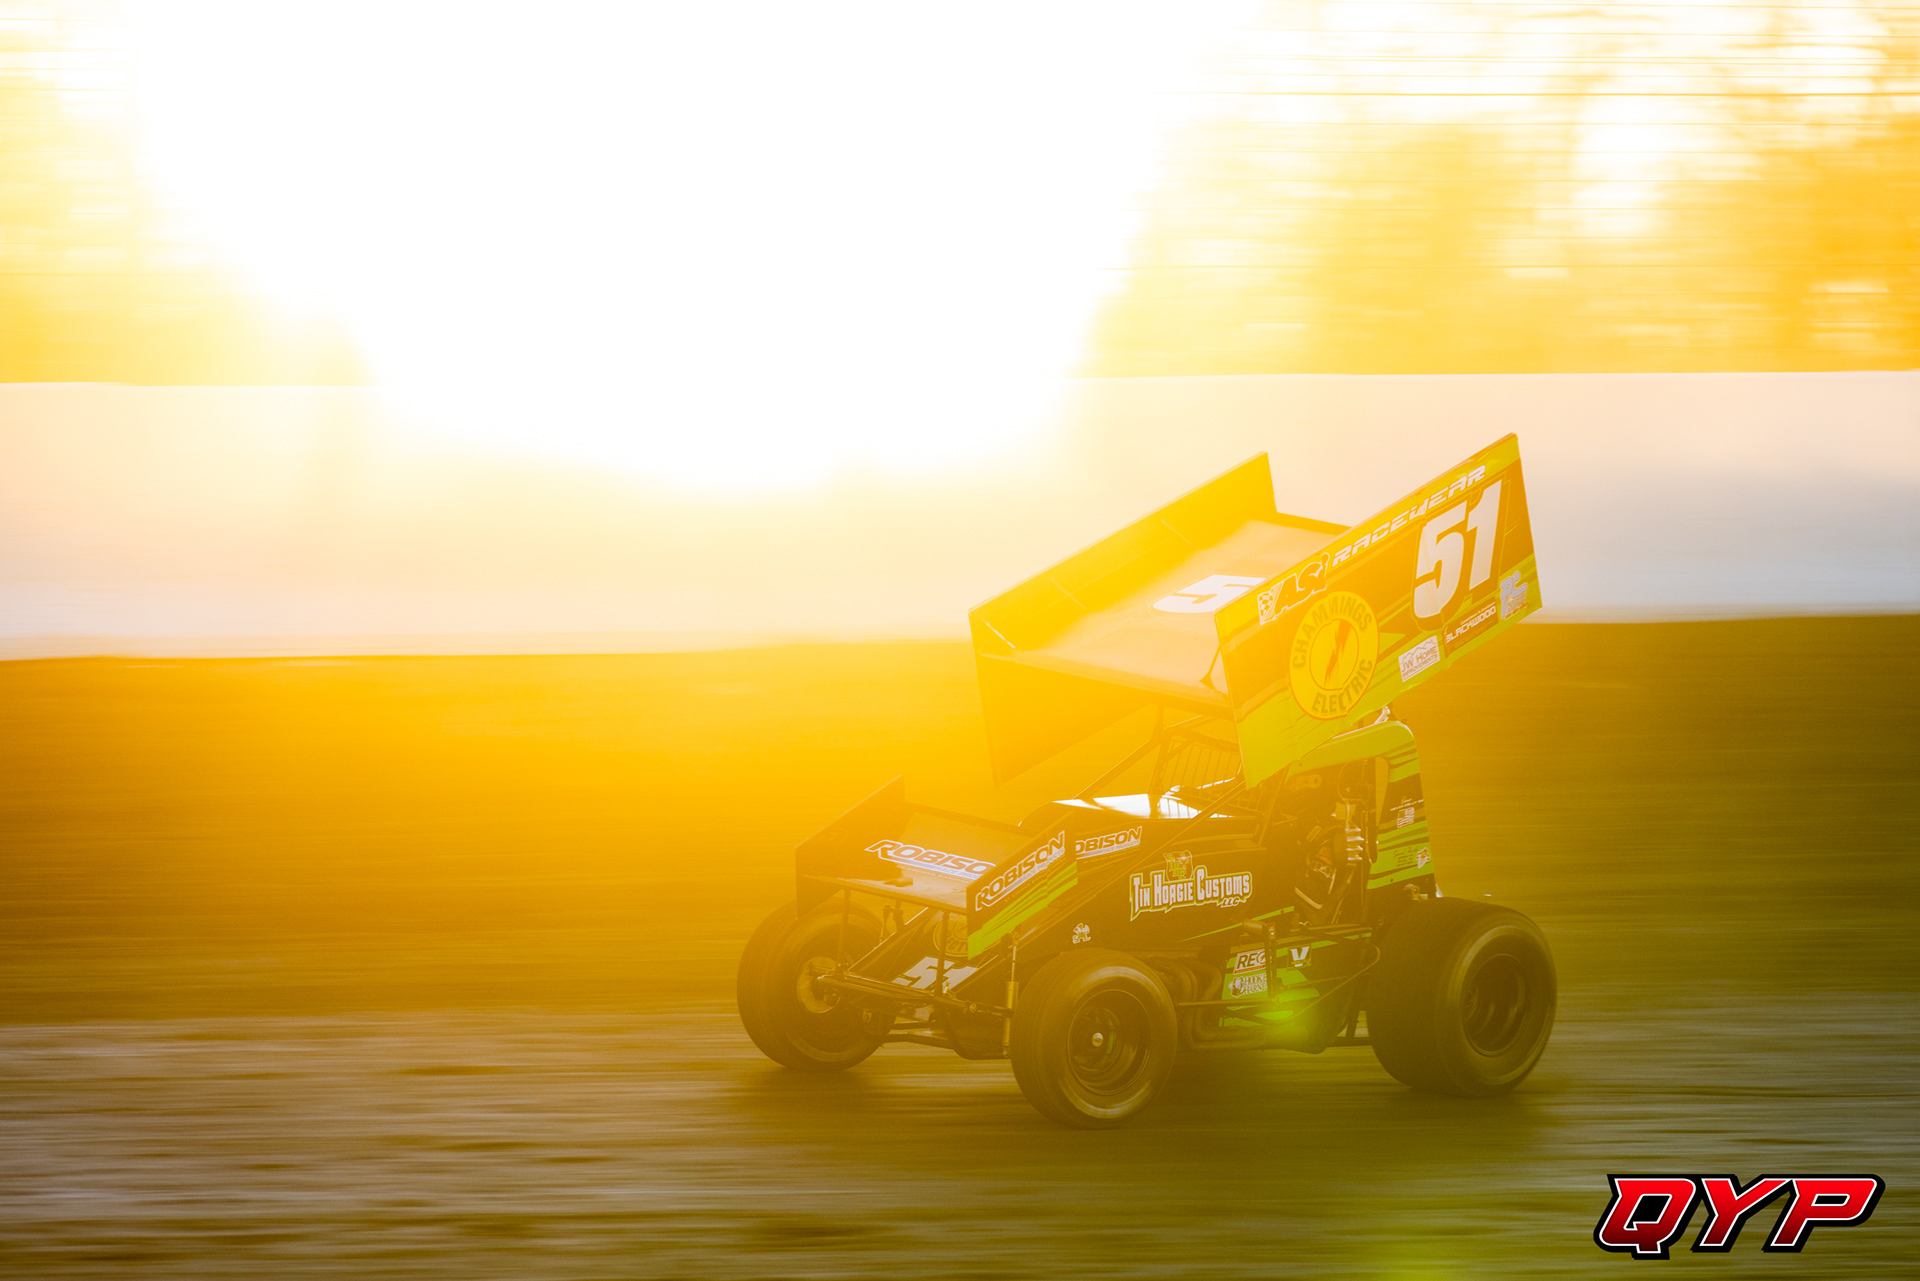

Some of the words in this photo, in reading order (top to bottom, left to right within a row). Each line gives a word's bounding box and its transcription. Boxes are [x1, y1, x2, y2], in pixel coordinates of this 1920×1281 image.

[1331, 464, 1487, 568] RACEWEAR
[1413, 478, 1503, 619] 51
[1152, 574, 1267, 614] 5
[1311, 658, 1373, 713] ELECTRIC
[864, 838, 997, 875] ROBISO
[1075, 825, 1143, 854] OBISON
[975, 830, 1065, 911] ROBISON
[1220, 896, 1241, 908] LLC
[891, 956, 979, 993] 51
[1244, 973, 1267, 985] HOOKE
